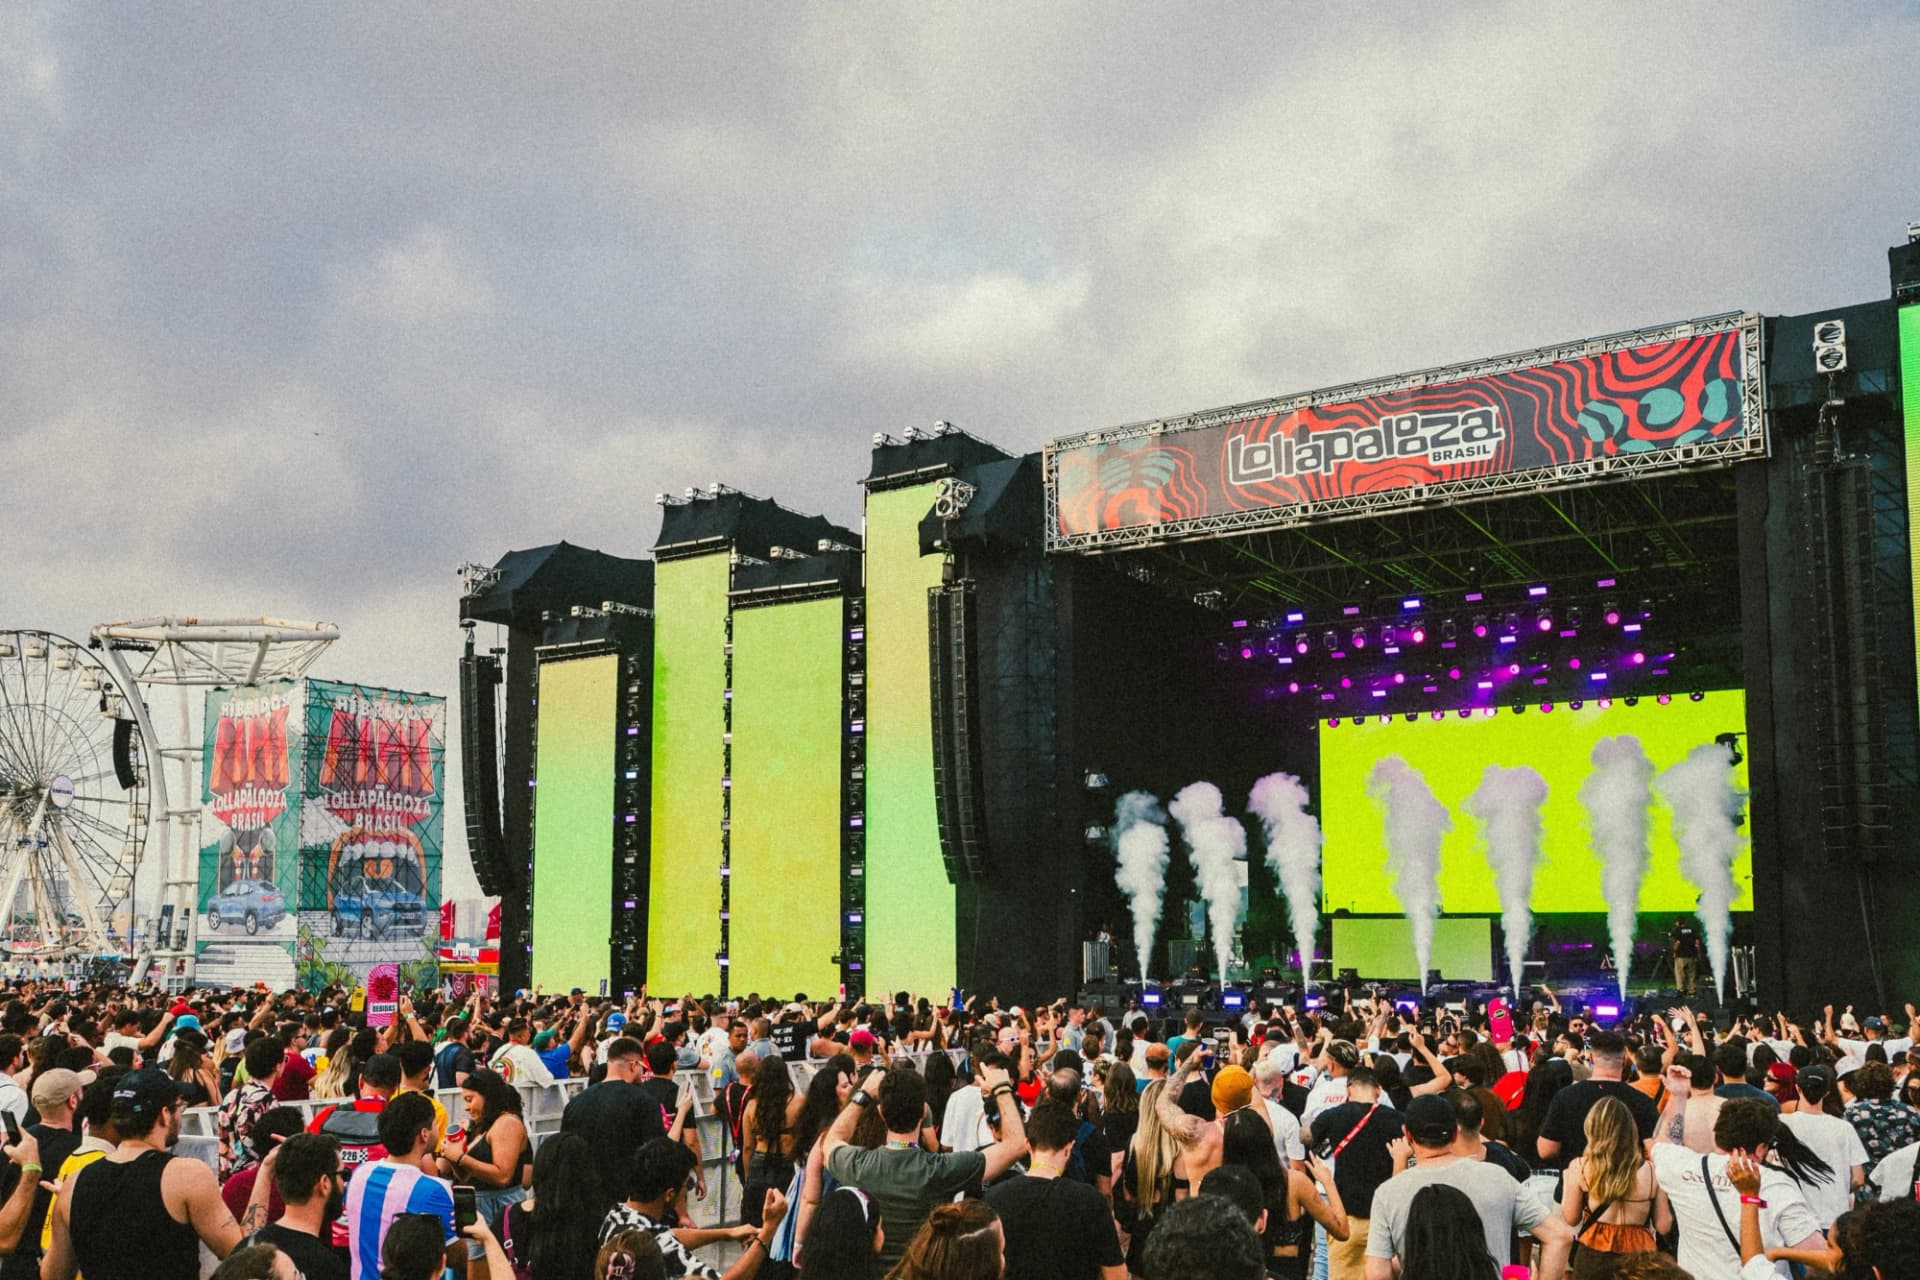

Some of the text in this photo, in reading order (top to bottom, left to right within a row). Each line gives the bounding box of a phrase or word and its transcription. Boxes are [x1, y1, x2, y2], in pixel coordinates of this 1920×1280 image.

[1230, 407, 1504, 483] Lollapalooza
[1431, 444, 1491, 462] BRASIL
[231, 811, 266, 831] BRASIL
[355, 812, 404, 832] BRASIL
[342, 1150, 358, 1161] 226
